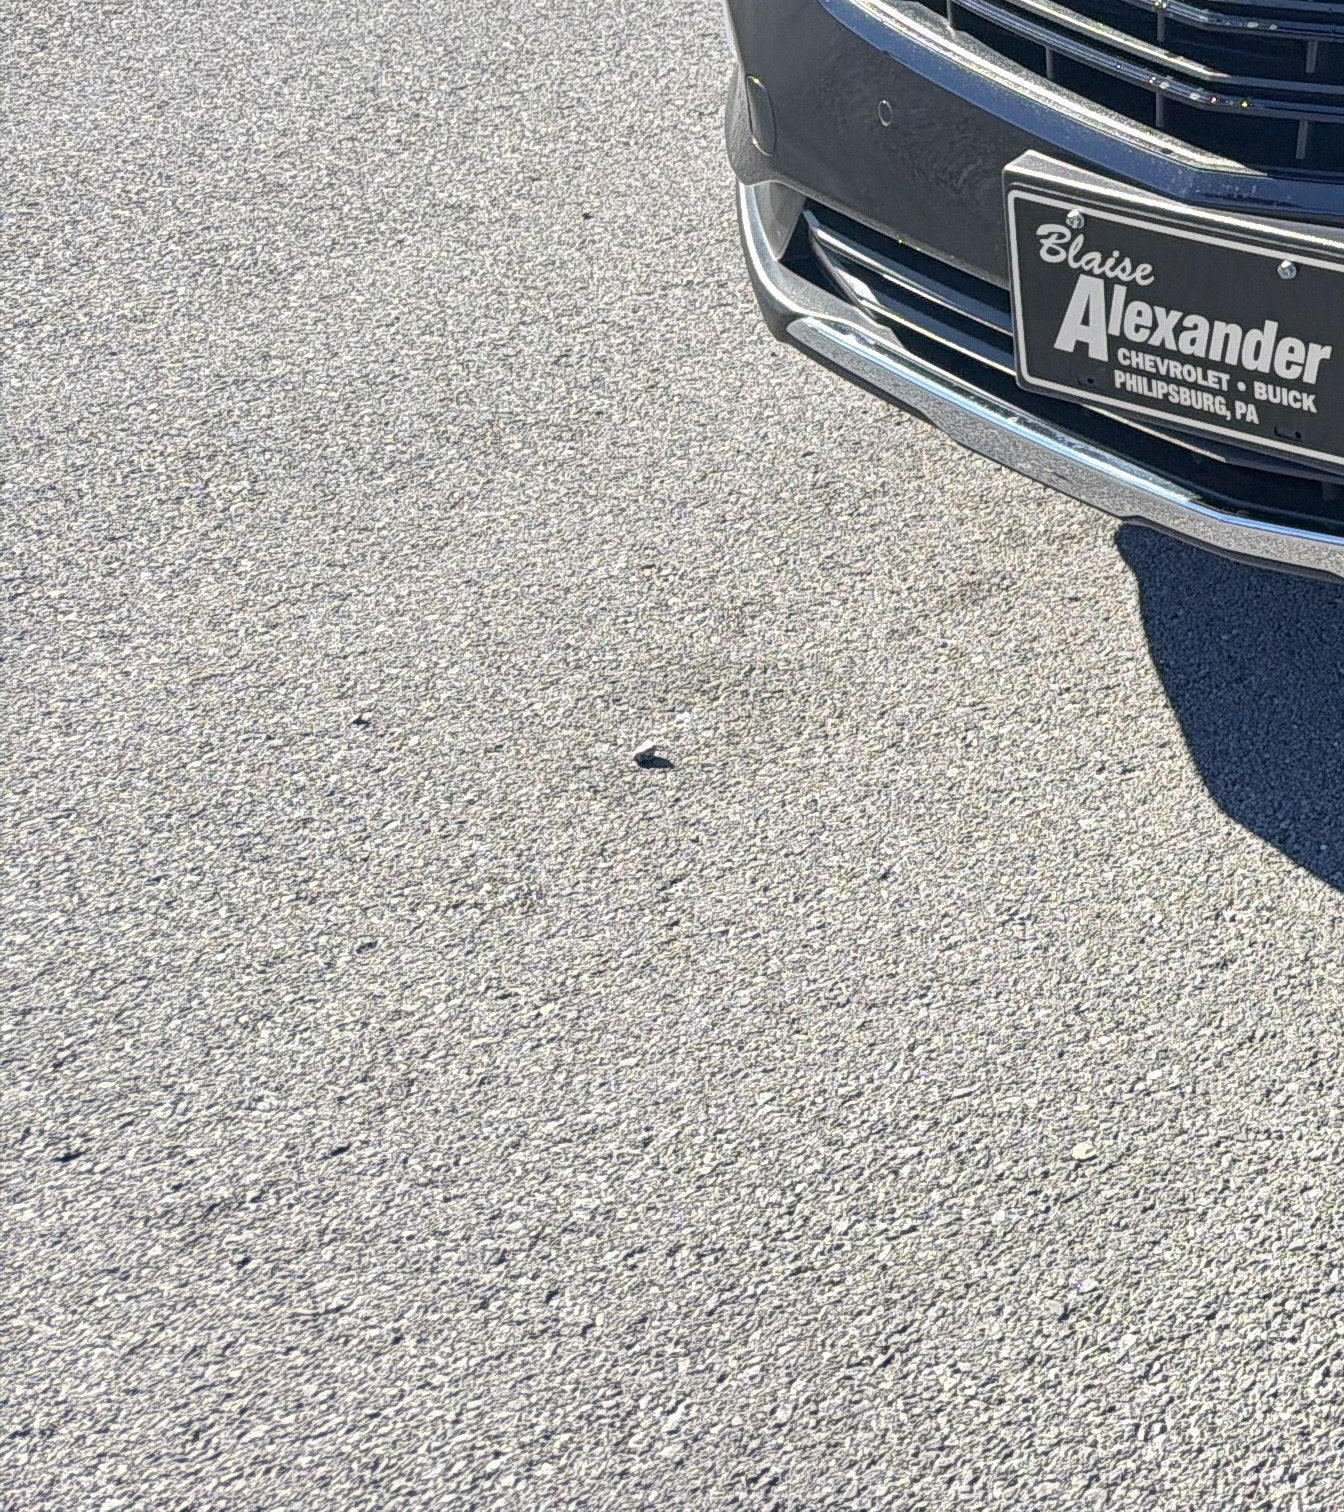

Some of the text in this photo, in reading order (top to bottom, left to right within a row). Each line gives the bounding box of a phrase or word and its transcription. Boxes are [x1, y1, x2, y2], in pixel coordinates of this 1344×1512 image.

[1035, 223, 1155, 286] Blaise
[1054, 274, 1332, 385] Alexander
[1114, 369, 1260, 425] PHILIPSBURG, PA
[1117, 347, 1318, 414] CHEVROLET BUICK
